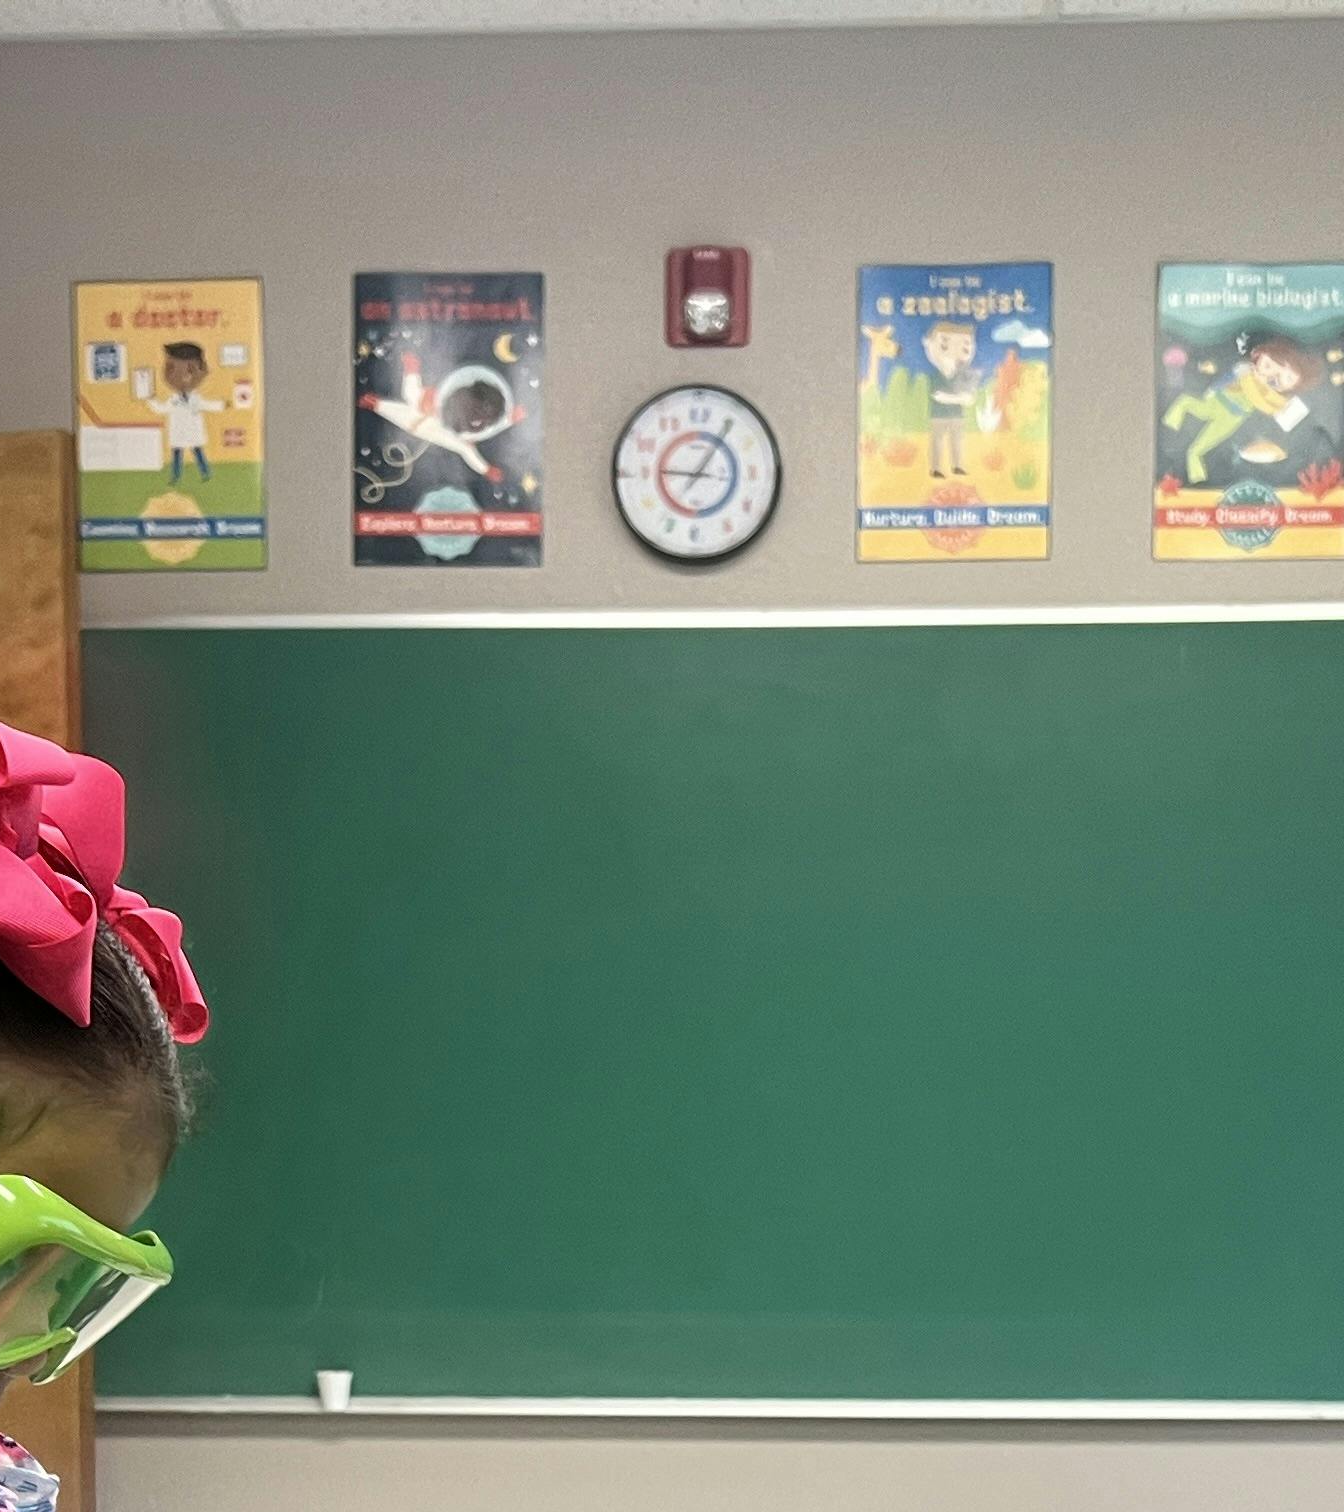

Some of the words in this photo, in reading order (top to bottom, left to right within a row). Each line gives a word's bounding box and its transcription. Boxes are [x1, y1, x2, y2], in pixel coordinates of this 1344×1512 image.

[877, 297, 894, 316] a
[1185, 290, 1250, 308] marine
[108, 311, 123, 328] a
